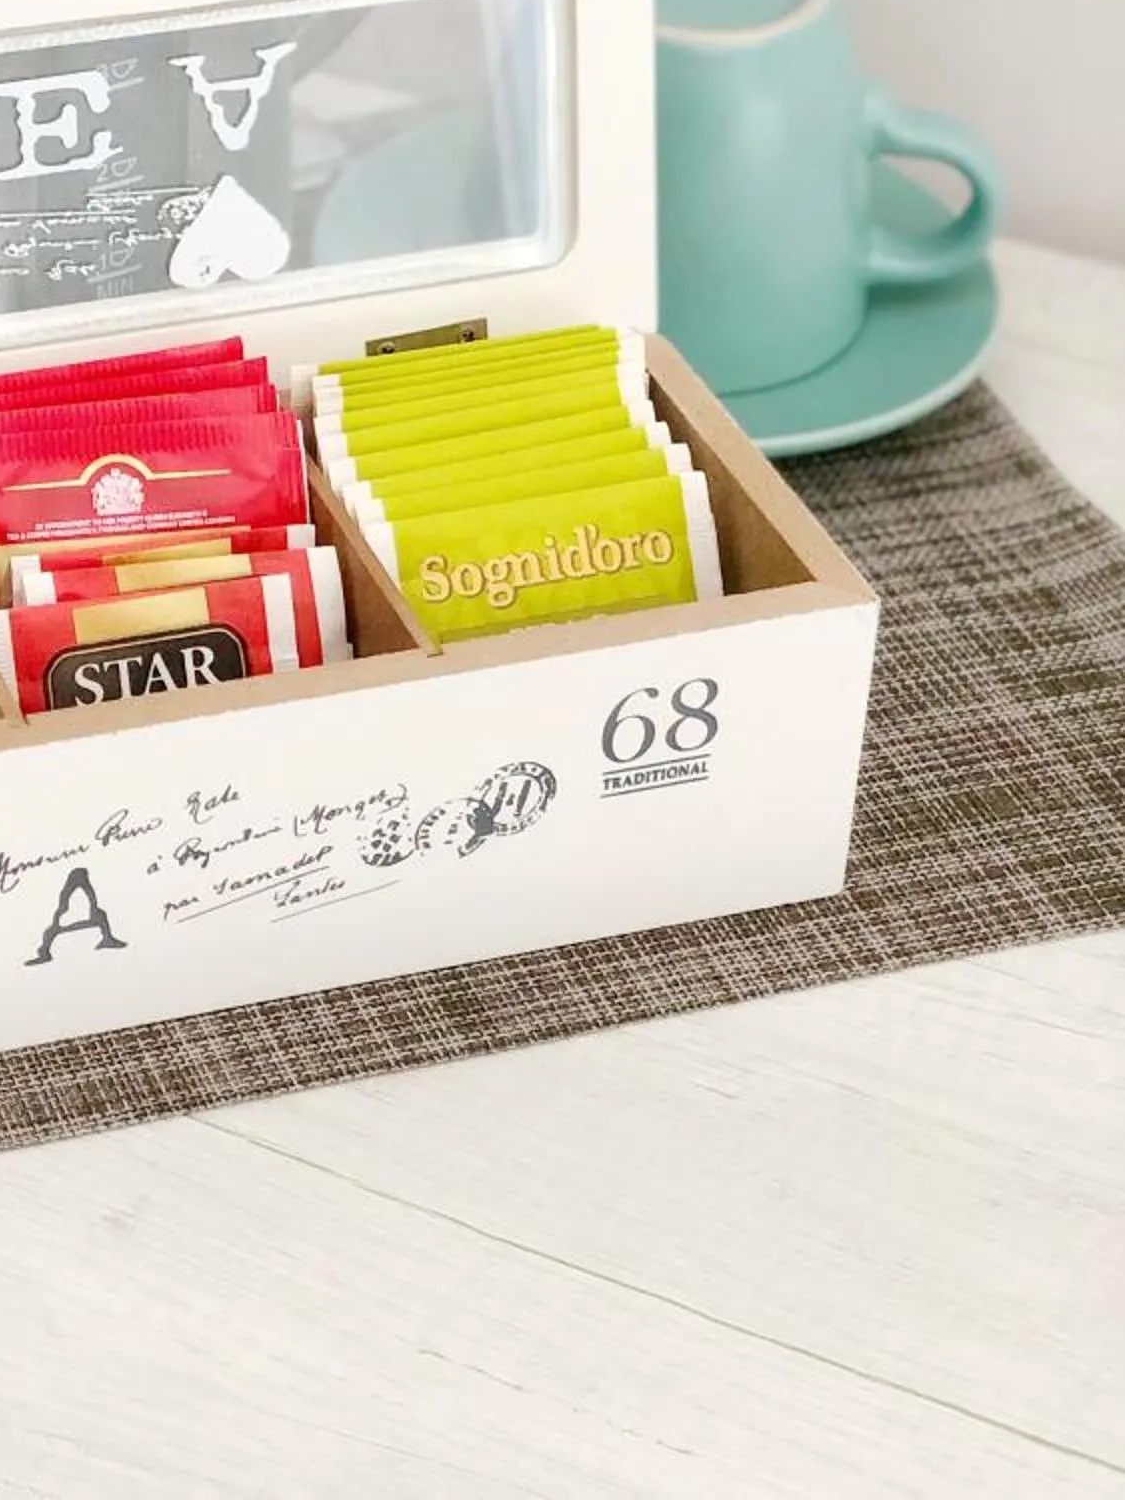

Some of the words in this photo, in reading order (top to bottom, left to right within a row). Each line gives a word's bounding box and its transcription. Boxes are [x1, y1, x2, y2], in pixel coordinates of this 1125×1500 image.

[74, 645, 222, 707] STAR
[602, 677, 719, 764] 68
[602, 761, 709, 791] TRADITIONAL
